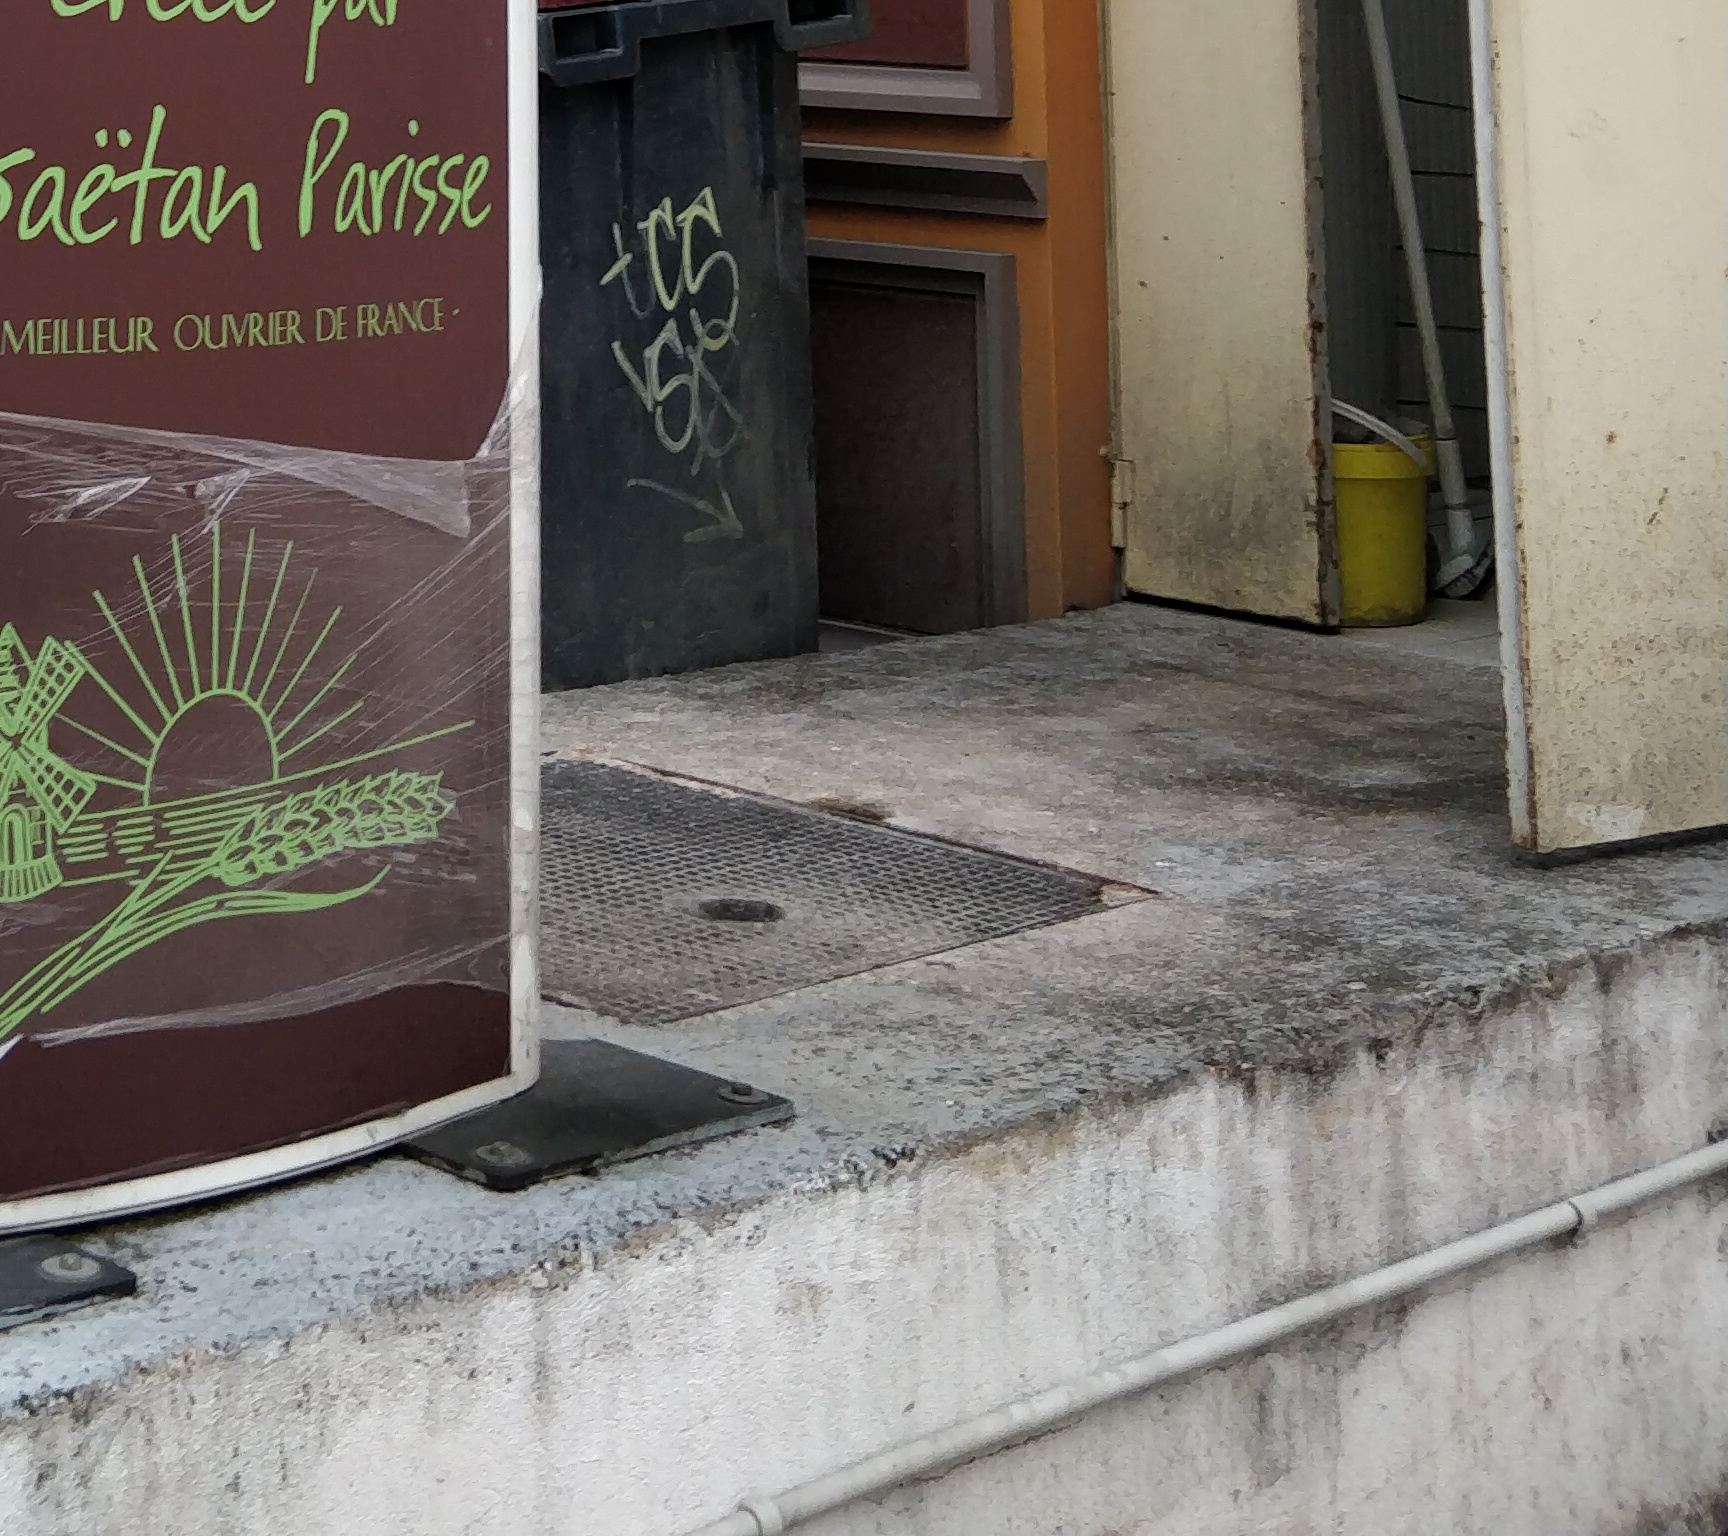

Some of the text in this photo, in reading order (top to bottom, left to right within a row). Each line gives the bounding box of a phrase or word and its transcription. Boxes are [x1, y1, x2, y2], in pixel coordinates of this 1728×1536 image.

[298, 108, 493, 239] Parisse
[0, 296, 445, 356] MEILLEUR OUVRIER DE FRANCE
